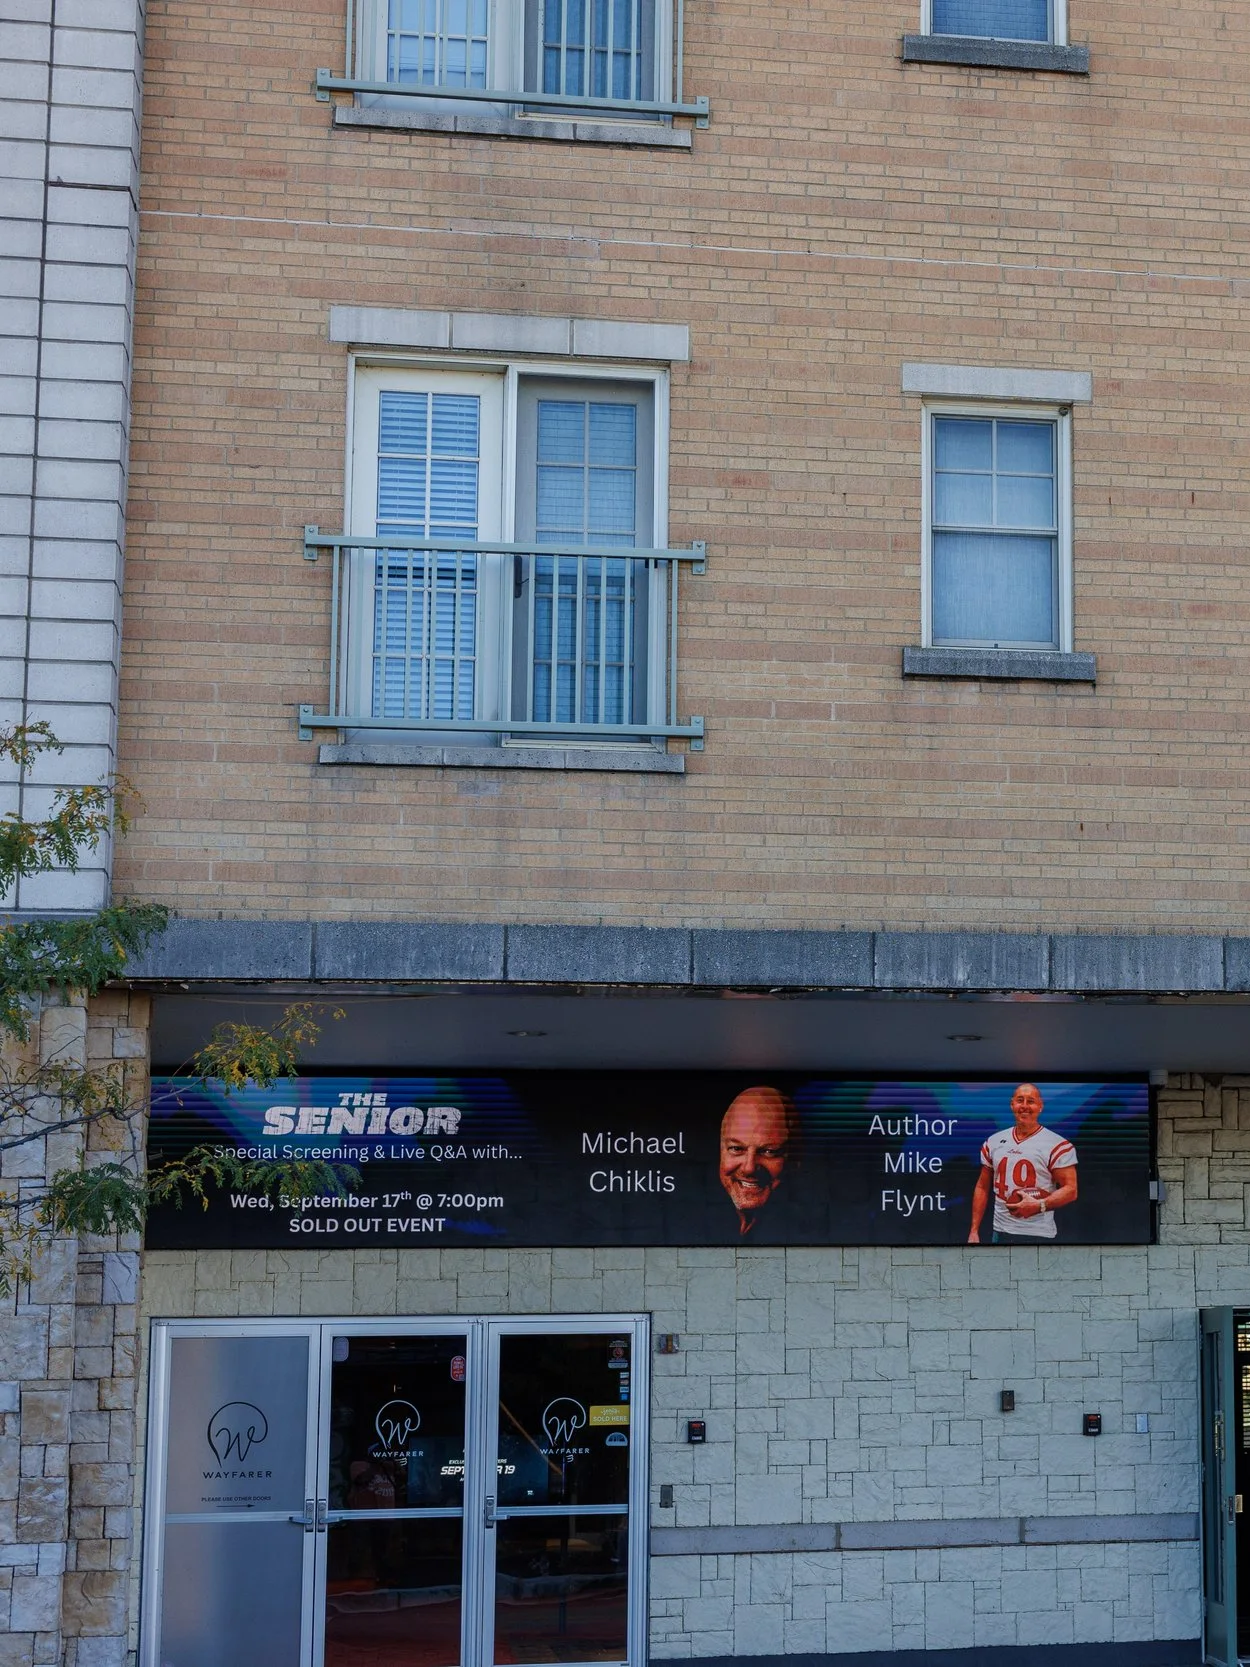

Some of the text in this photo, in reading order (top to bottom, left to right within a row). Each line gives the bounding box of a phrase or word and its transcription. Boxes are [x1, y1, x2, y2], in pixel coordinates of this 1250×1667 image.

[338, 1093, 387, 1106] THE
[262, 1106, 462, 1136] SENIOR
[868, 1113, 958, 1136] Author
[583, 1132, 686, 1154] Michael
[213, 1144, 523, 1163] Special Screening & Live Q&A with...
[885, 1152, 943, 1174] Mike
[589, 1170, 676, 1193] Chiklis
[230, 1190, 504, 1212] Wed, September 17th @ 7:00pm
[882, 1190, 946, 1217] Flynt
[289, 1217, 446, 1233] SOLD OUT EVENT
[611, 1415, 628, 1423] HERE
[372, 1450, 424, 1458] WAYFARER
[539, 1447, 590, 1456] WAYFARER
[203, 1470, 273, 1480] WAYFARER
[504, 1465, 516, 1475] 19
